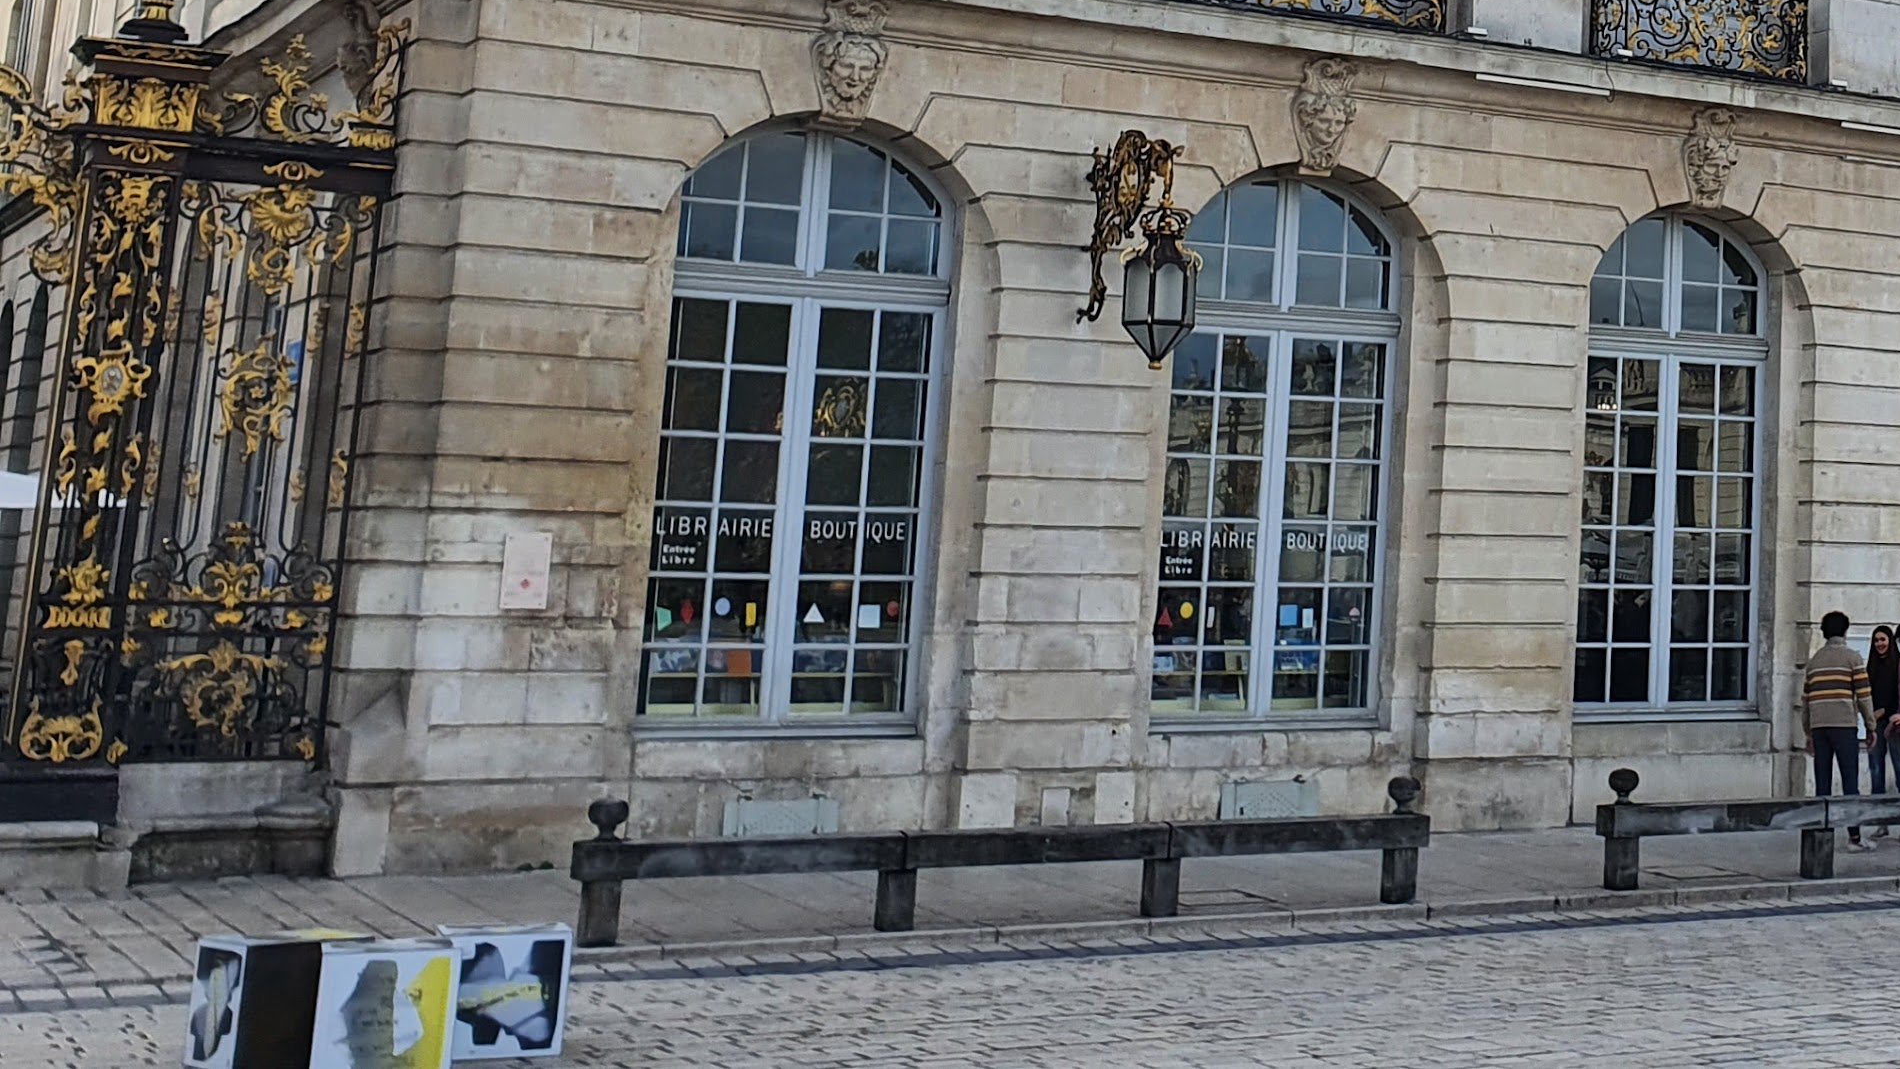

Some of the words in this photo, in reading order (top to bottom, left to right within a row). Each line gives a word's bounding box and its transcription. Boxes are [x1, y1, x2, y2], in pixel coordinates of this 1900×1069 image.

[656, 515, 773, 538] LIBRAIRIE
[810, 519, 906, 544] BOUTIQUE
[1160, 530, 1256, 549] LIBRAIRIE
[1286, 532, 1368, 553] BOUTIQUE
[661, 554, 696, 565] Libre
[1164, 565, 1193, 575] Libre
